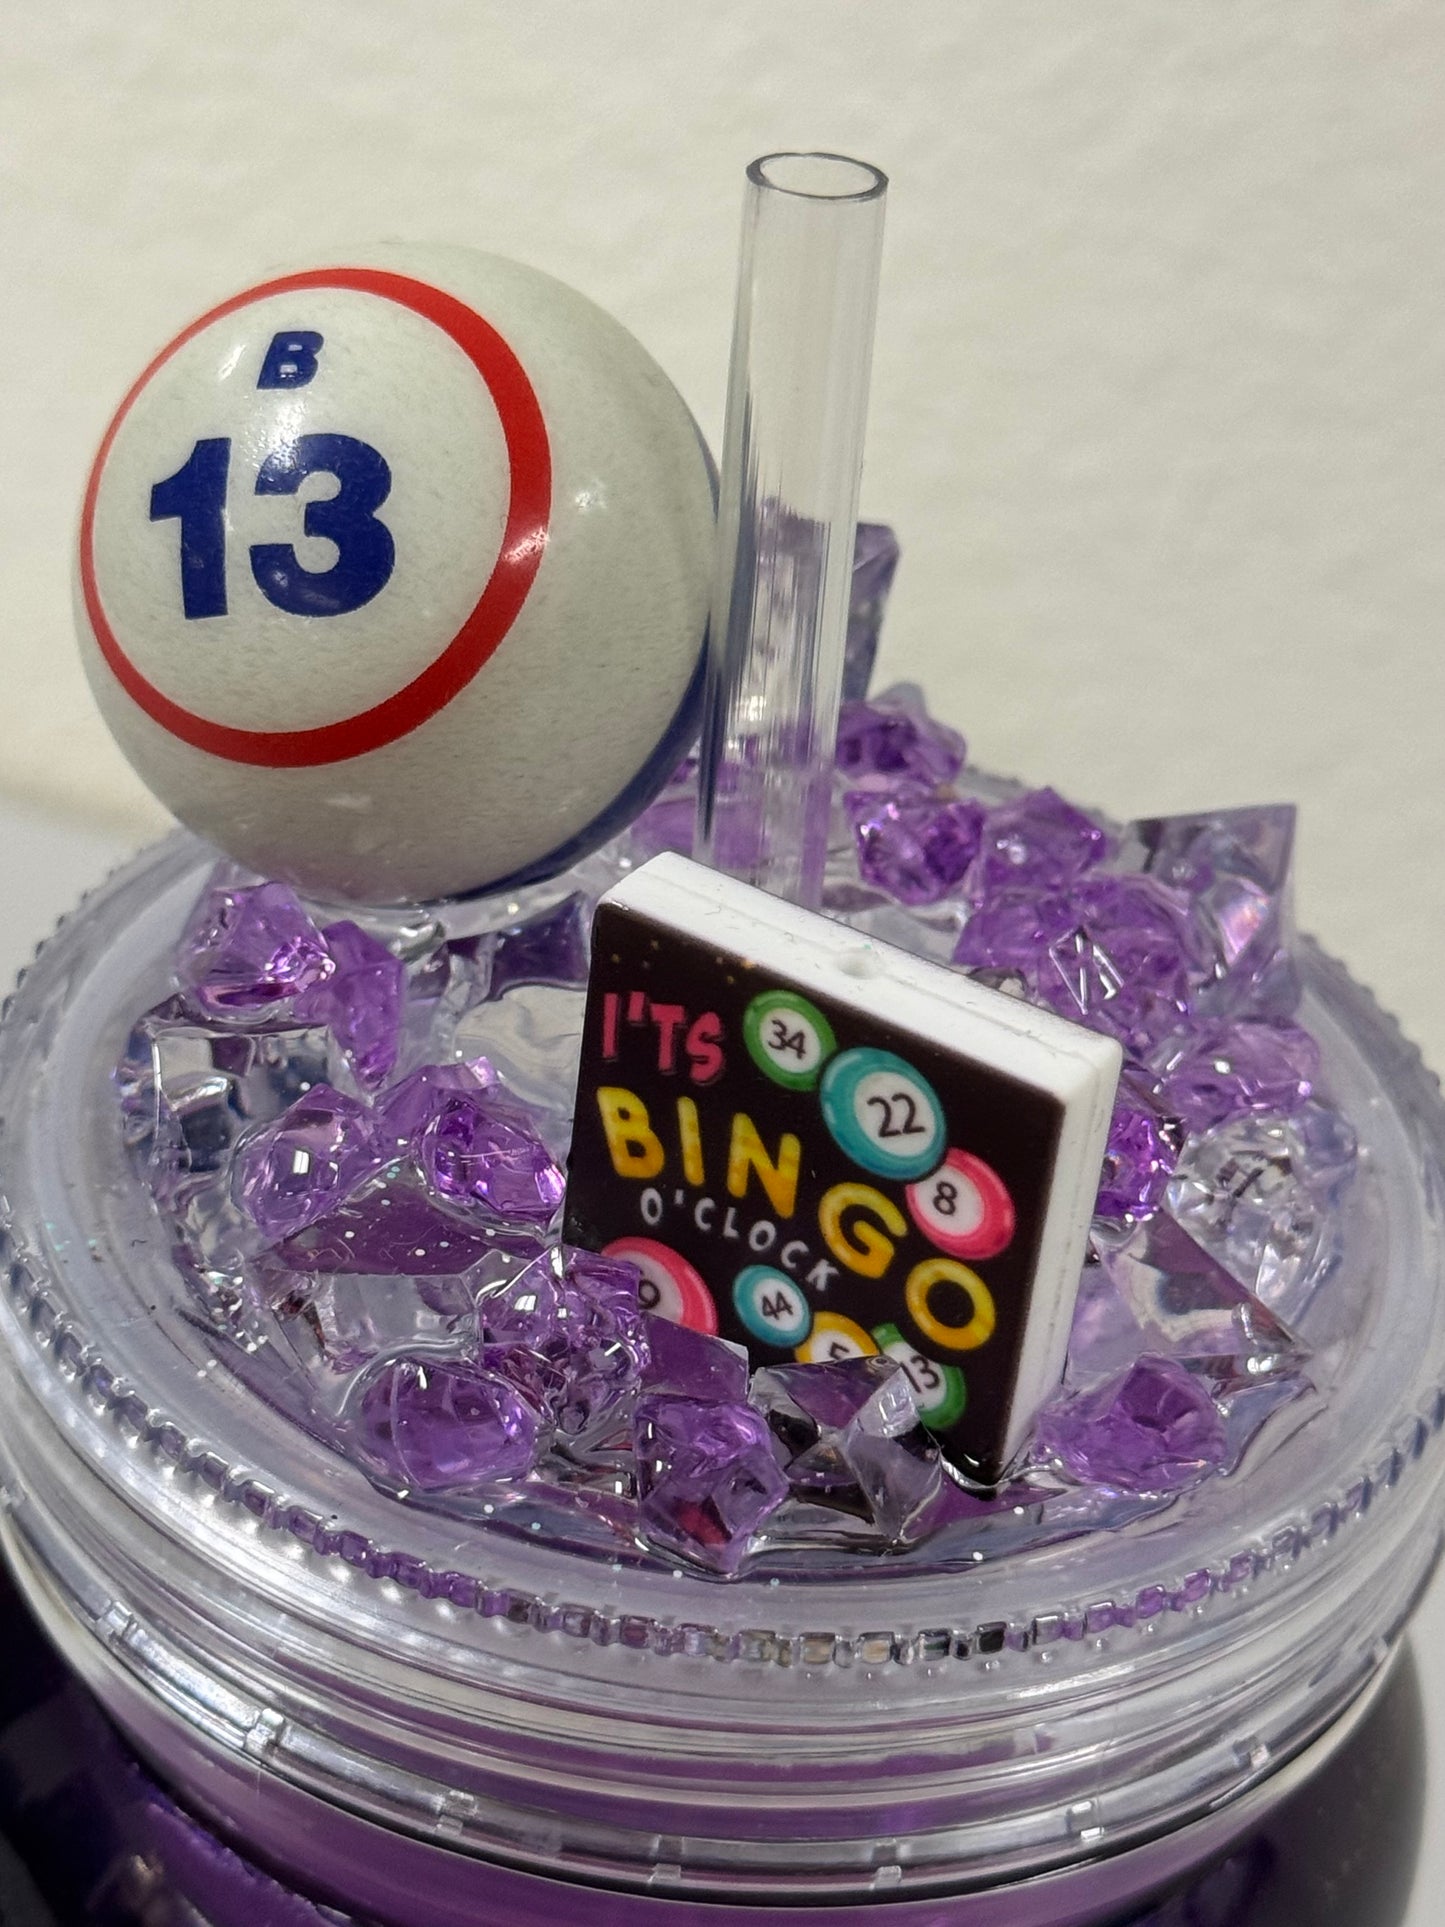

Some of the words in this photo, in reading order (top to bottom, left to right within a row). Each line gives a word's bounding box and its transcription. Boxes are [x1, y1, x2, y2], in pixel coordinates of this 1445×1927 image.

[257, 331, 325, 390] B
[150, 432, 396, 621] 13
[602, 991, 727, 1085] I'TS
[768, 1019, 807, 1060] 34
[867, 1093, 926, 1138] 22
[596, 1086, 996, 1350] BINGO
[932, 1181, 958, 1217] 8
[640, 1187, 839, 1292] O'CLOCK
[761, 1291, 794, 1320] 44
[900, 1354, 941, 1394] 13
